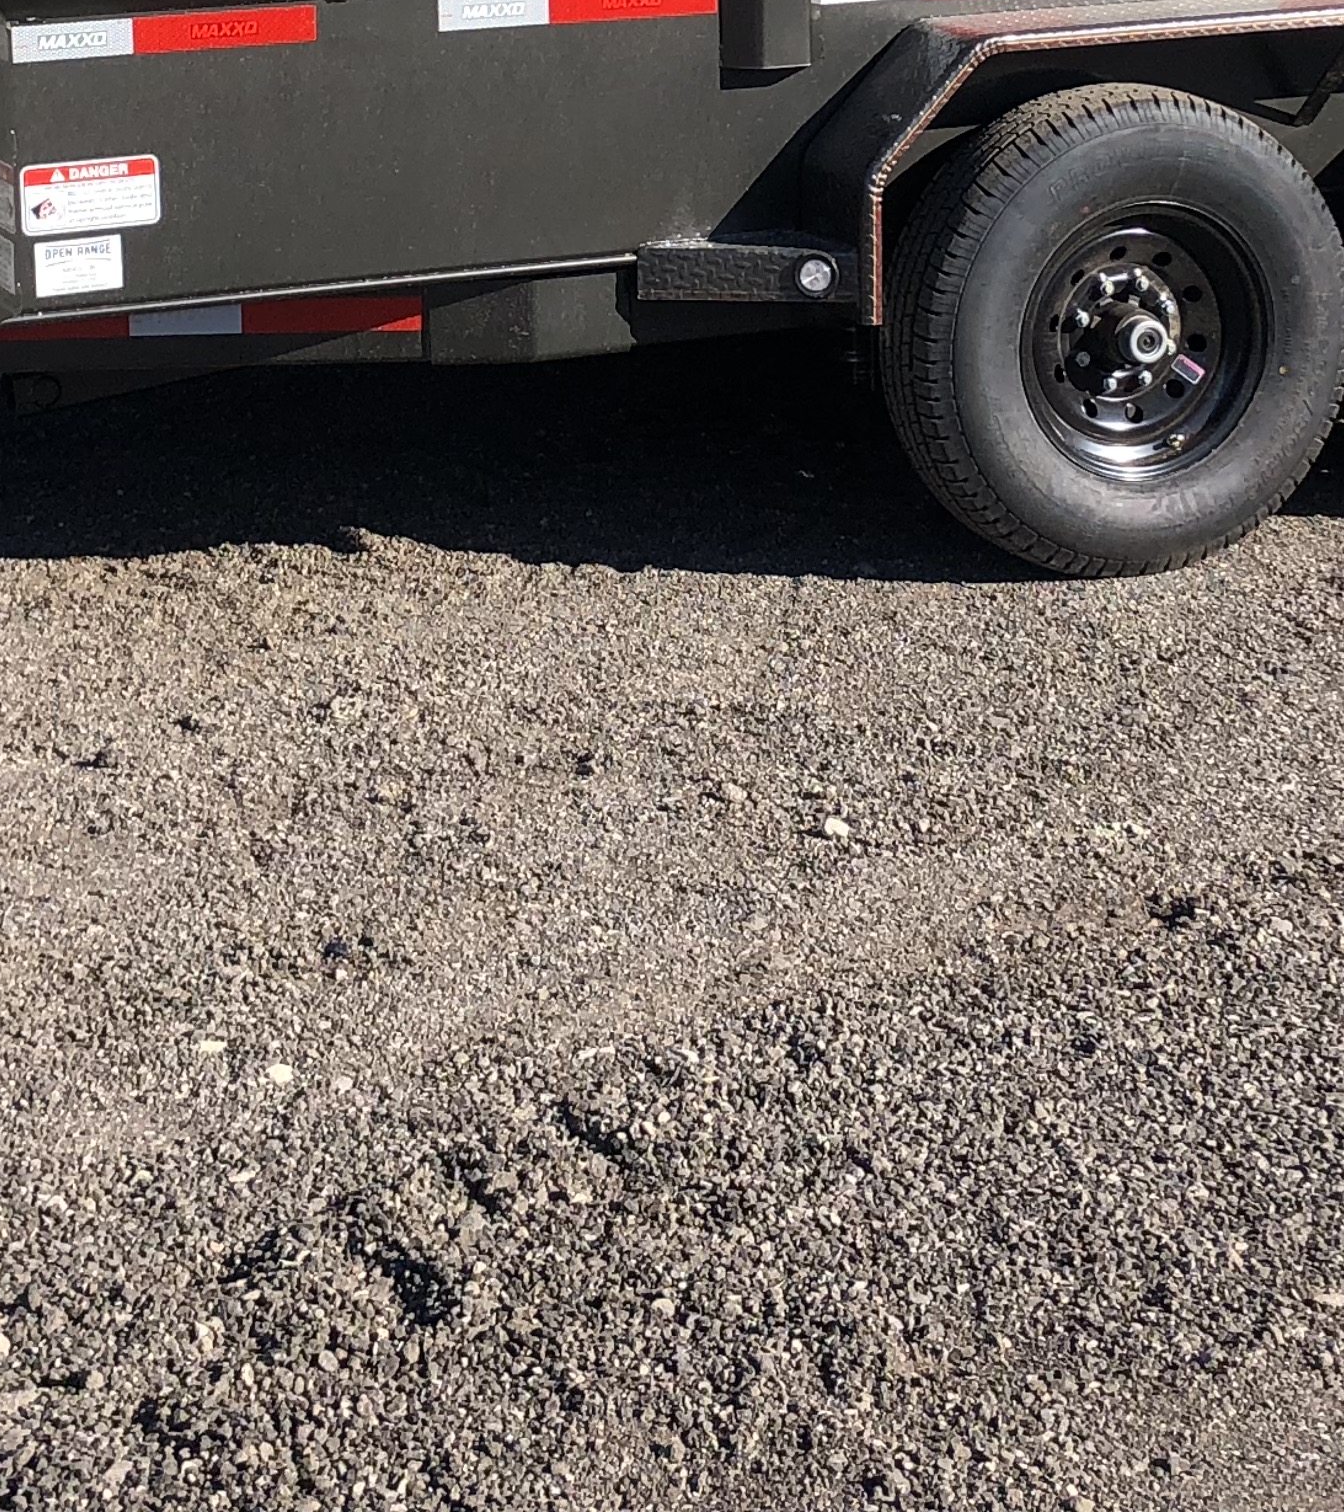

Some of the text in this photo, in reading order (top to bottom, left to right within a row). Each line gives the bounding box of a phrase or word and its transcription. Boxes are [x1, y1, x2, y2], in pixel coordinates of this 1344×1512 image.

[462, 2, 526, 20] MAXXD
[191, 20, 259, 40] MAXXD
[37, 31, 108, 51] MAXXD
[68, 162, 129, 180] DANGER
[44, 242, 112, 261] OPEN RANGE
